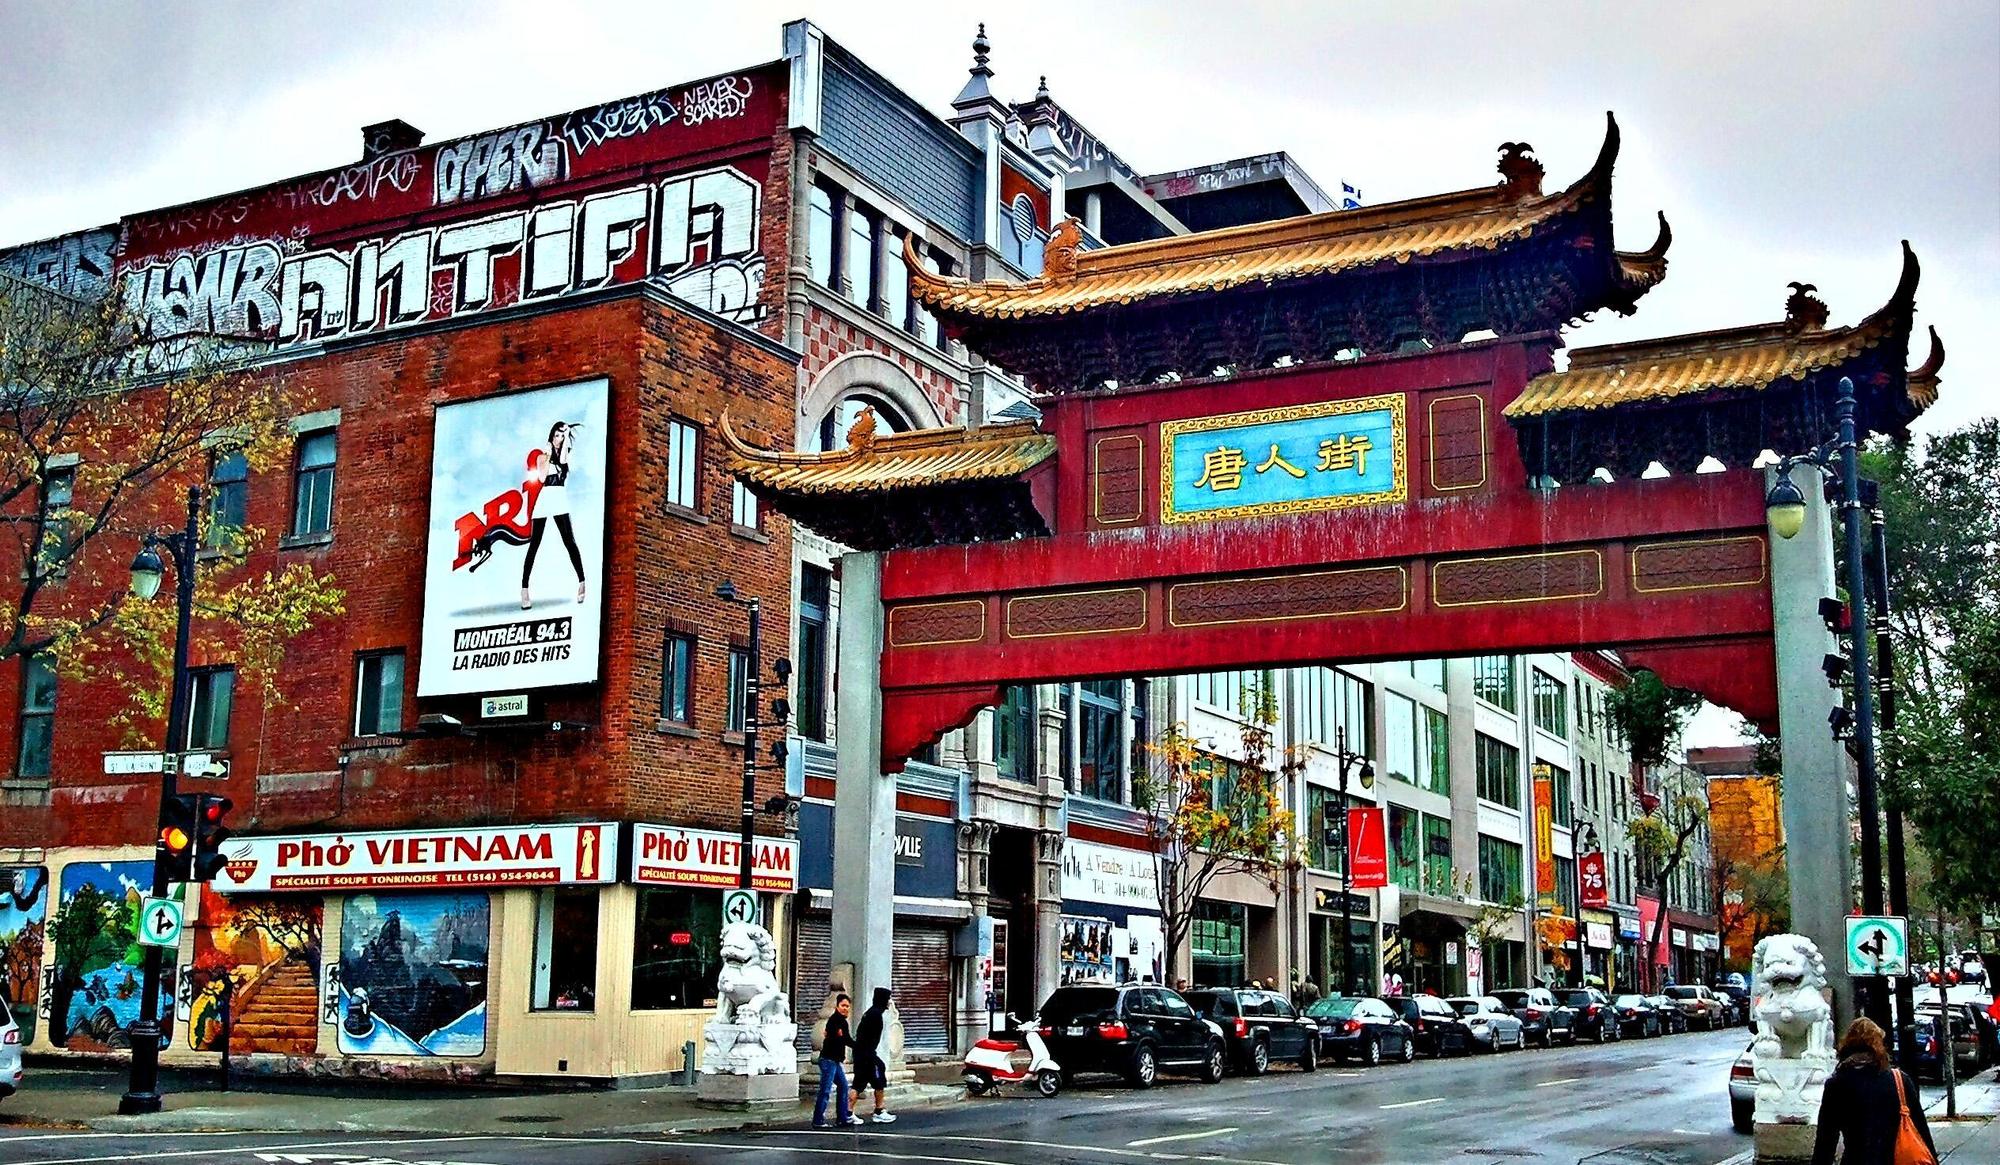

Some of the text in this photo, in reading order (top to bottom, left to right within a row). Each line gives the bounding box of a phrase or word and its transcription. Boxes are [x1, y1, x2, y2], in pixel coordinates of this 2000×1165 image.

[684, 76, 753, 106] NEVER
[683, 94, 745, 126] SCARED!
[1193, 433, 1373, 492] 唐人街
[452, 448, 545, 572] NRJ
[456, 621, 570, 650] MONTRÉAL 94.3
[452, 644, 571, 671] LA RADIO DES HITS
[498, 700, 523, 712] astral
[366, 833, 553, 865] VIETNAM
[275, 875, 330, 886] SPÉCIALITÉ
[333, 876, 368, 885] SOUPE
[371, 874, 438, 885] TONKINOISE
[445, 873, 463, 882] TEL
[466, 872, 497, 882] (514)
[1583, 873, 1603, 889] 75
